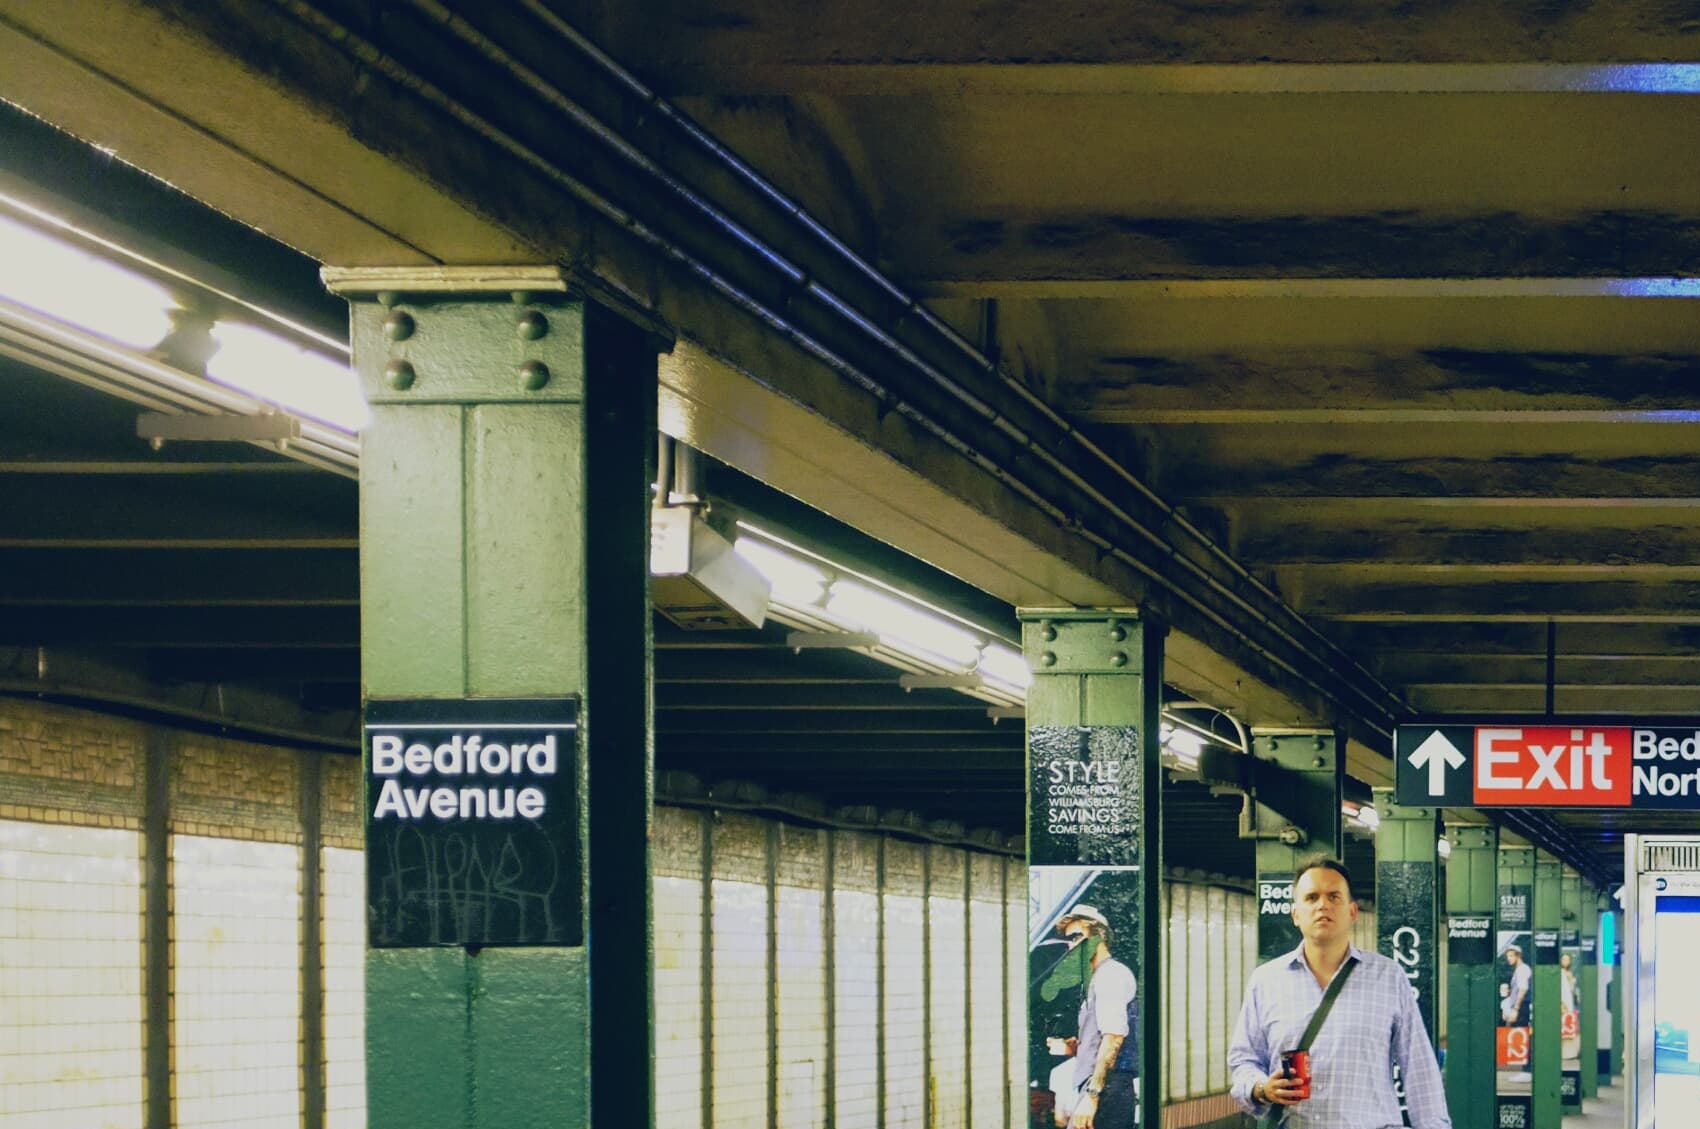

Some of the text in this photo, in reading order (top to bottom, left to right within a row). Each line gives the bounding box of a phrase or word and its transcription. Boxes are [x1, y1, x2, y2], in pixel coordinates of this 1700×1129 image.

[371, 735, 556, 775] Bedford
[1477, 728, 1613, 790] Exit
[1049, 760, 1120, 784] STYLE
[373, 779, 545, 819] Avenue
[1048, 785, 1119, 796] COMES FROM
[1048, 808, 1120, 823] SAVINGS
[1048, 824, 1078, 834] COME
[1079, 824, 1105, 835] FROM
[1448, 919, 1490, 929] Bedford
[1448, 929, 1487, 938] Avenue
[1506, 1027, 1529, 1065] C21
